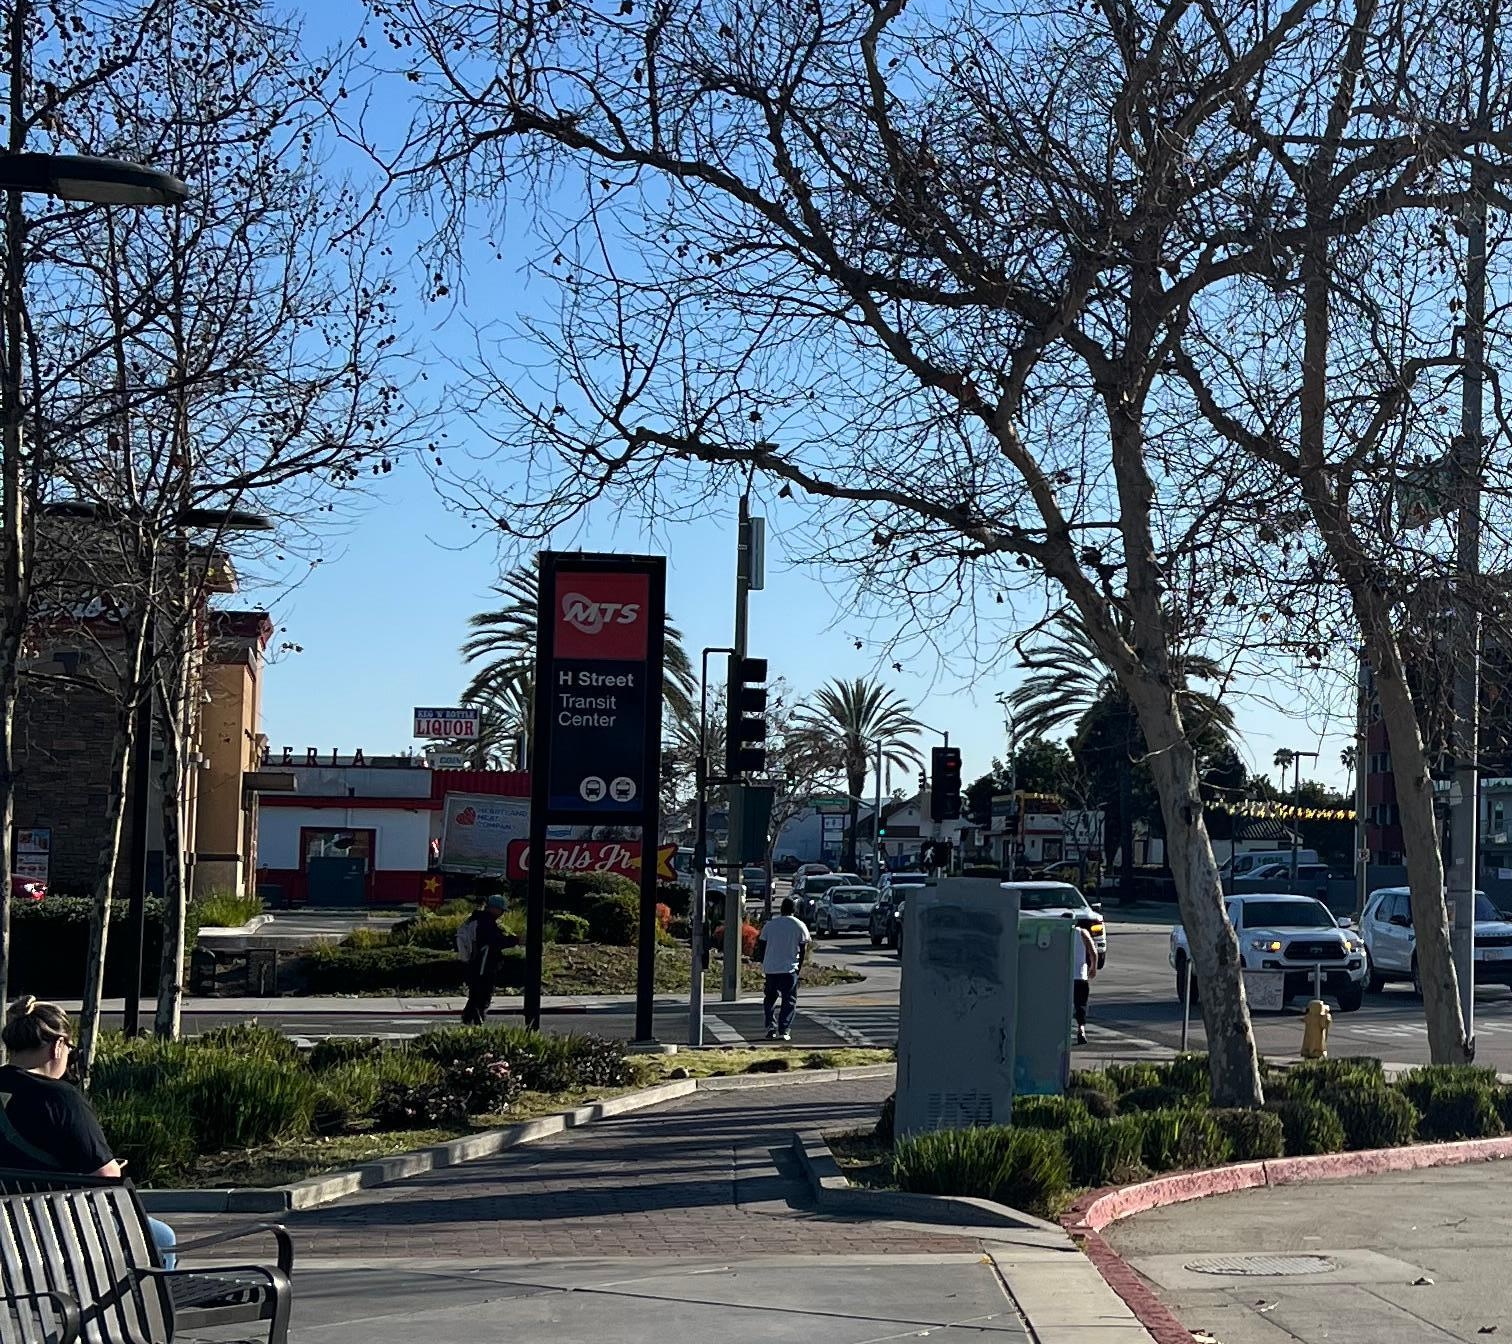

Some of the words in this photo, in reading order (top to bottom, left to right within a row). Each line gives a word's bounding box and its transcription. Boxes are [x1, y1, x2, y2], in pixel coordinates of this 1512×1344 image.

[562, 602, 641, 625] MTS
[559, 671, 572, 686] H
[578, 671, 634, 687] Street
[559, 693, 617, 710] Transit
[445, 710, 475, 719] BOTTLE
[558, 711, 617, 727] Center
[416, 719, 474, 736] LIQUOR
